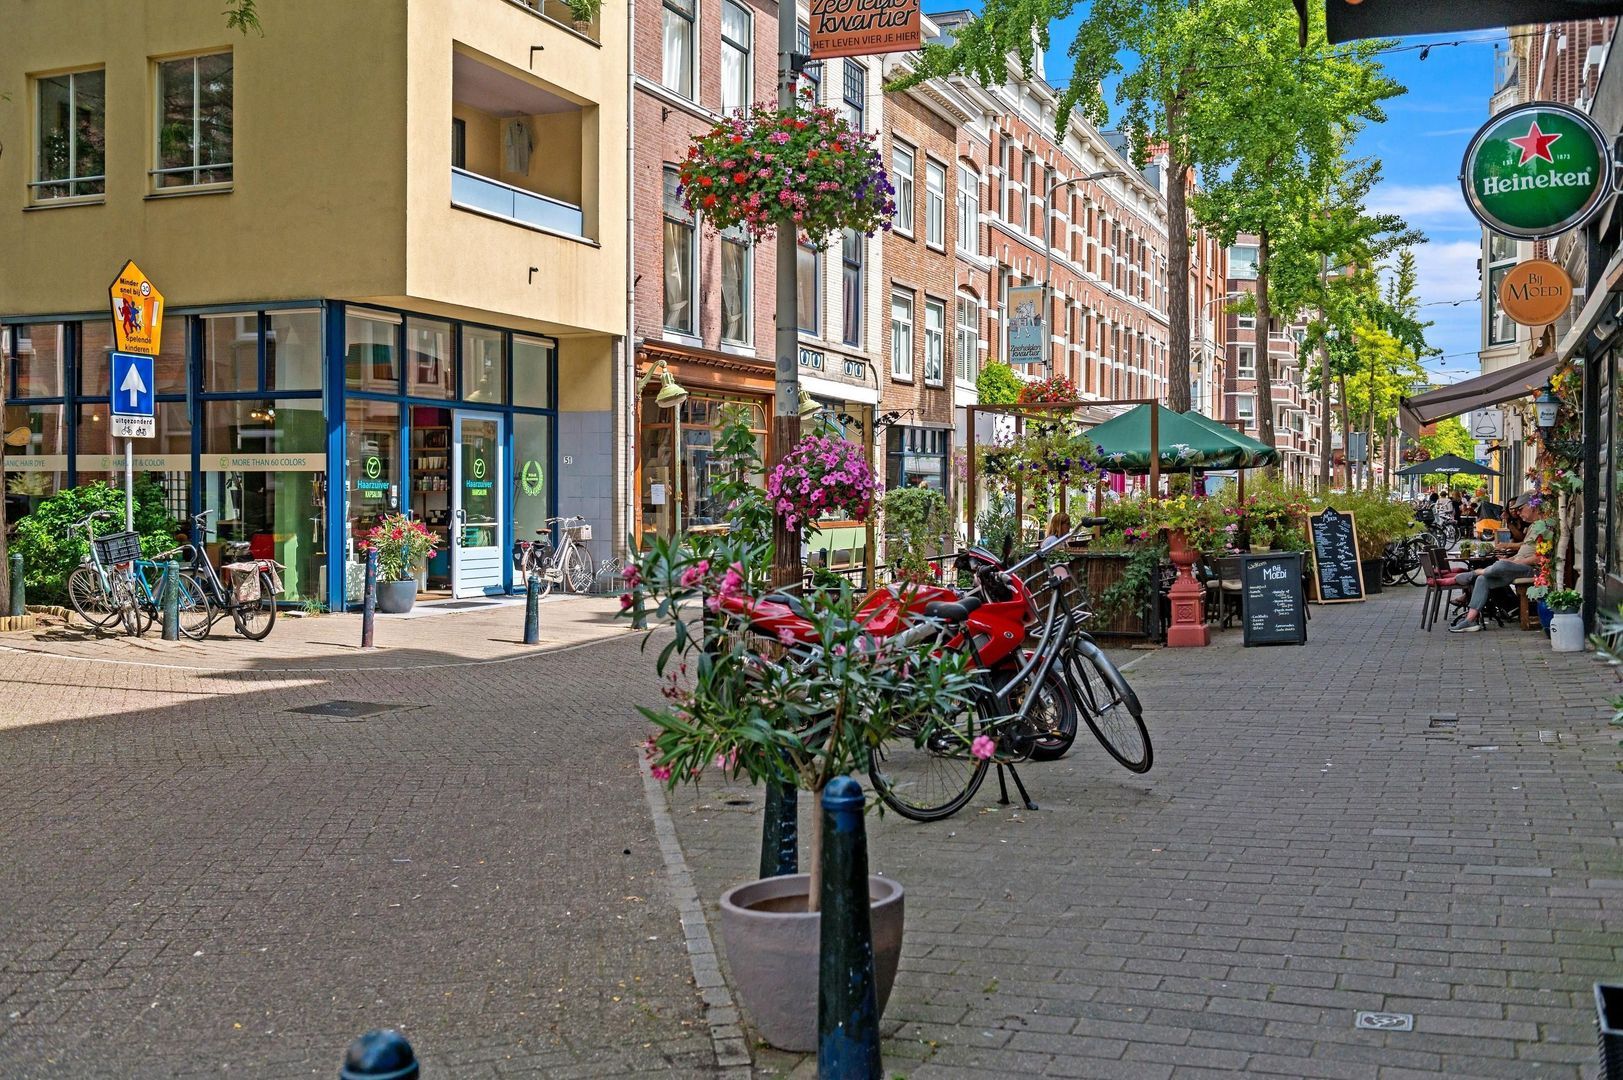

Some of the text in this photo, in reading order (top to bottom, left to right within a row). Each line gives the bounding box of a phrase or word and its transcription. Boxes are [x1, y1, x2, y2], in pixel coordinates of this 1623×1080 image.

[813, 31, 919, 49] HET LEVEN VIER JE HIER!
[1483, 169, 1591, 196] Heineken
[119, 278, 139, 287] Minder
[132, 288, 141, 297] bij
[142, 285, 149, 293] 30
[115, 418, 153, 426] uitgezonderd
[20, 459, 33, 467] HAIR
[34, 459, 46, 467] DYE
[144, 458, 165, 467] COLOR
[280, 458, 306, 466] COLORS
[357, 479, 389, 490] Haarzuiver
